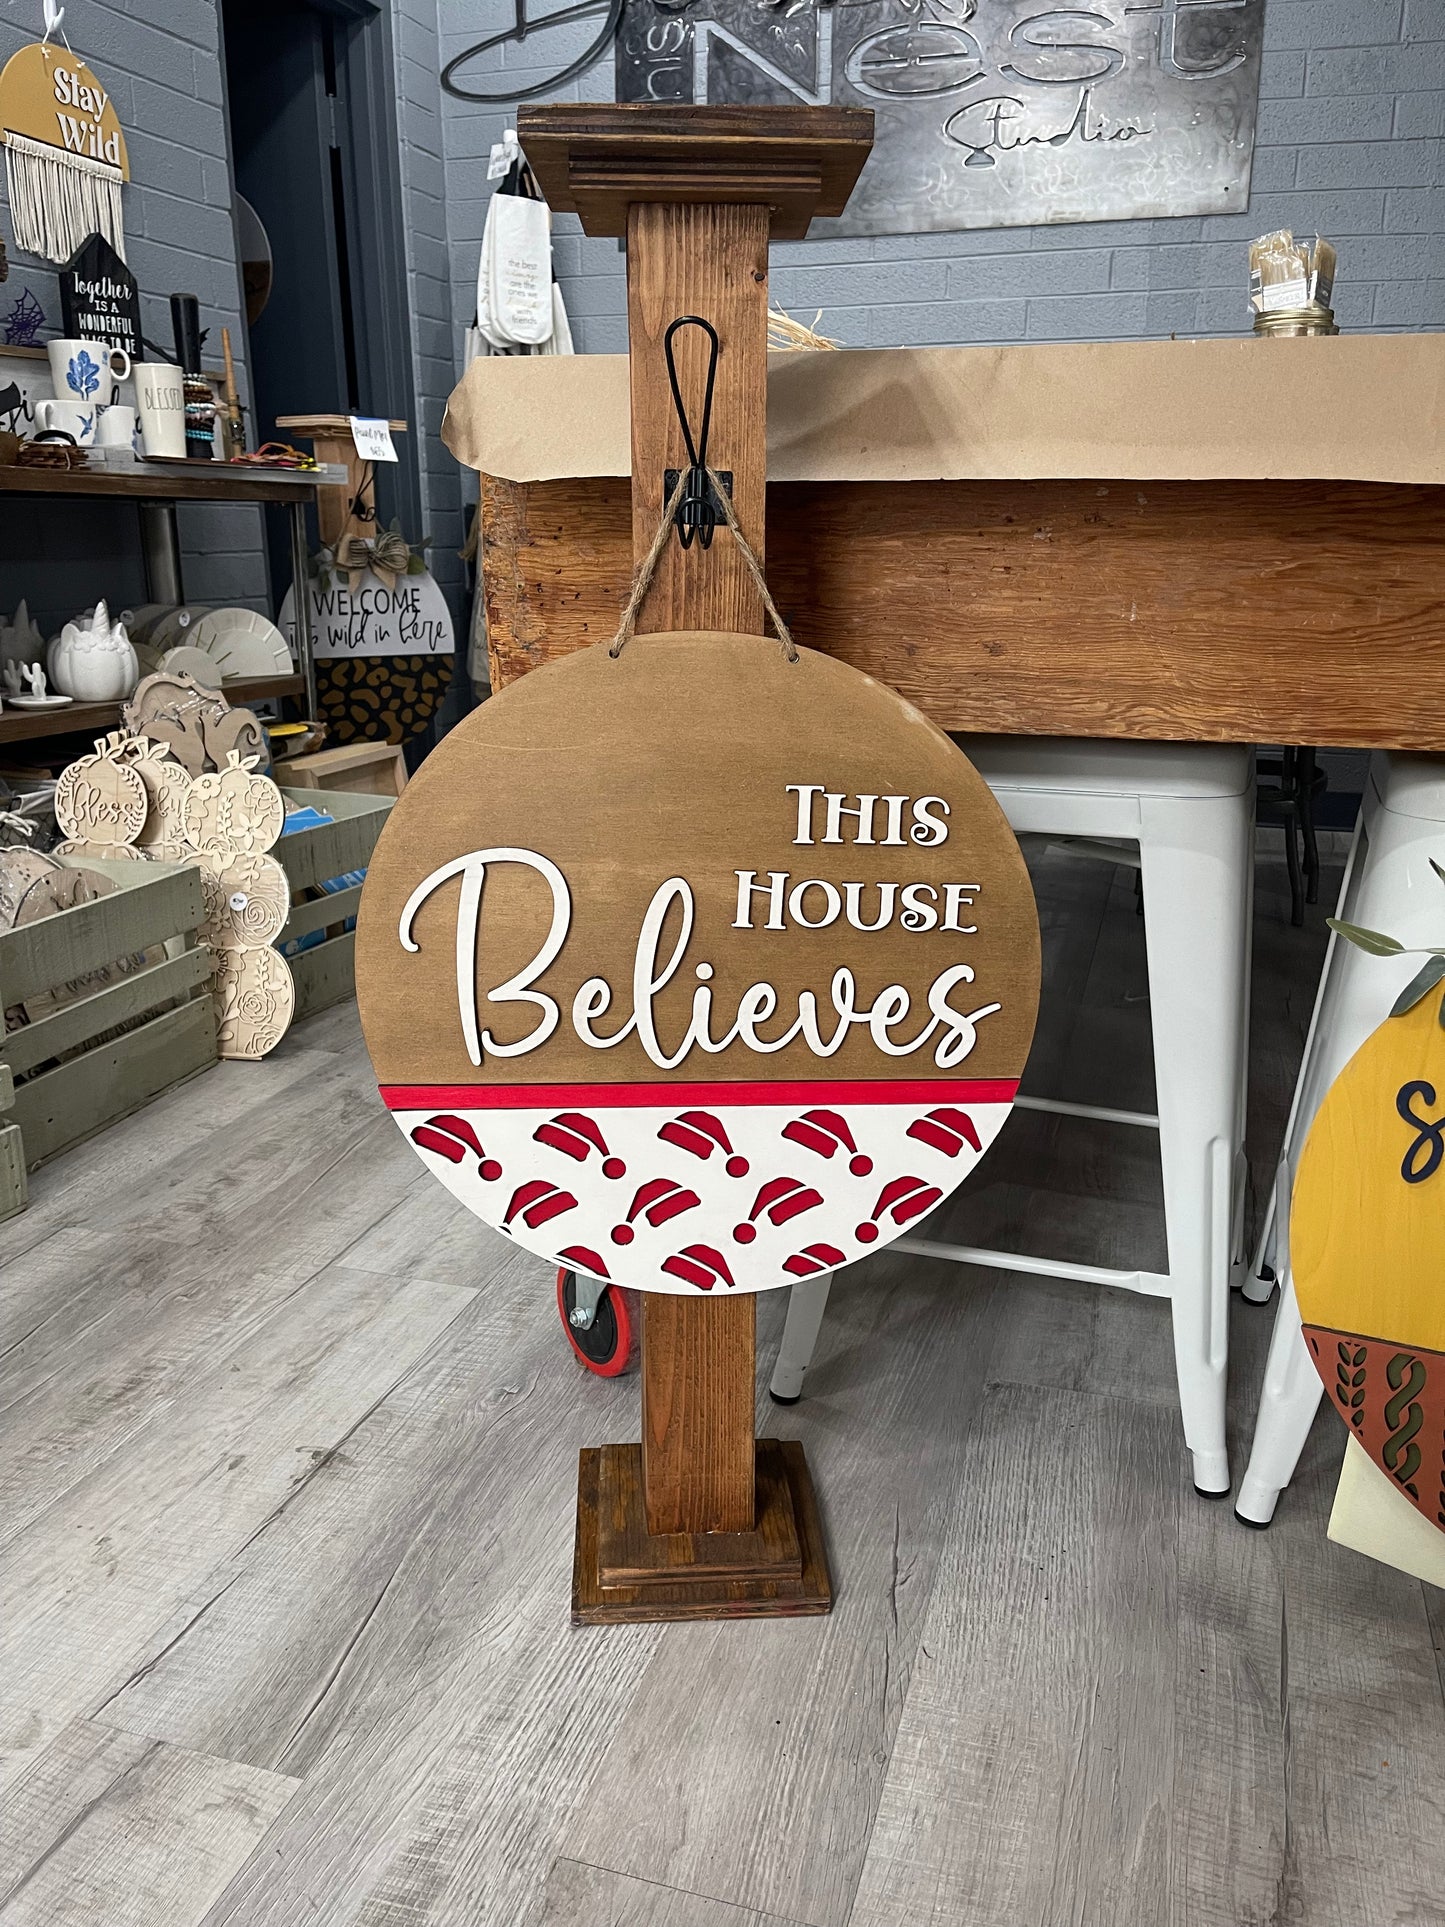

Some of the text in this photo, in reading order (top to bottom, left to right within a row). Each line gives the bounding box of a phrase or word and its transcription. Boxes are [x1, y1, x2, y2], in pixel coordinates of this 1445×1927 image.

[53, 67, 108, 123] Stay
[56, 112, 120, 166] Wild
[943, 88, 1153, 169] Studio
[73, 271, 132, 303] Together
[95, 300, 120, 313] IS A
[78, 312, 135, 336] WONDERFUL
[312, 588, 421, 616] WELCOME
[327, 610, 366, 649] wild
[374, 623, 391, 644] in
[399, 603, 447, 651] here
[784, 783, 951, 848] THIS
[730, 869, 982, 935] HOUSE
[398, 846, 1002, 1070] Believes
